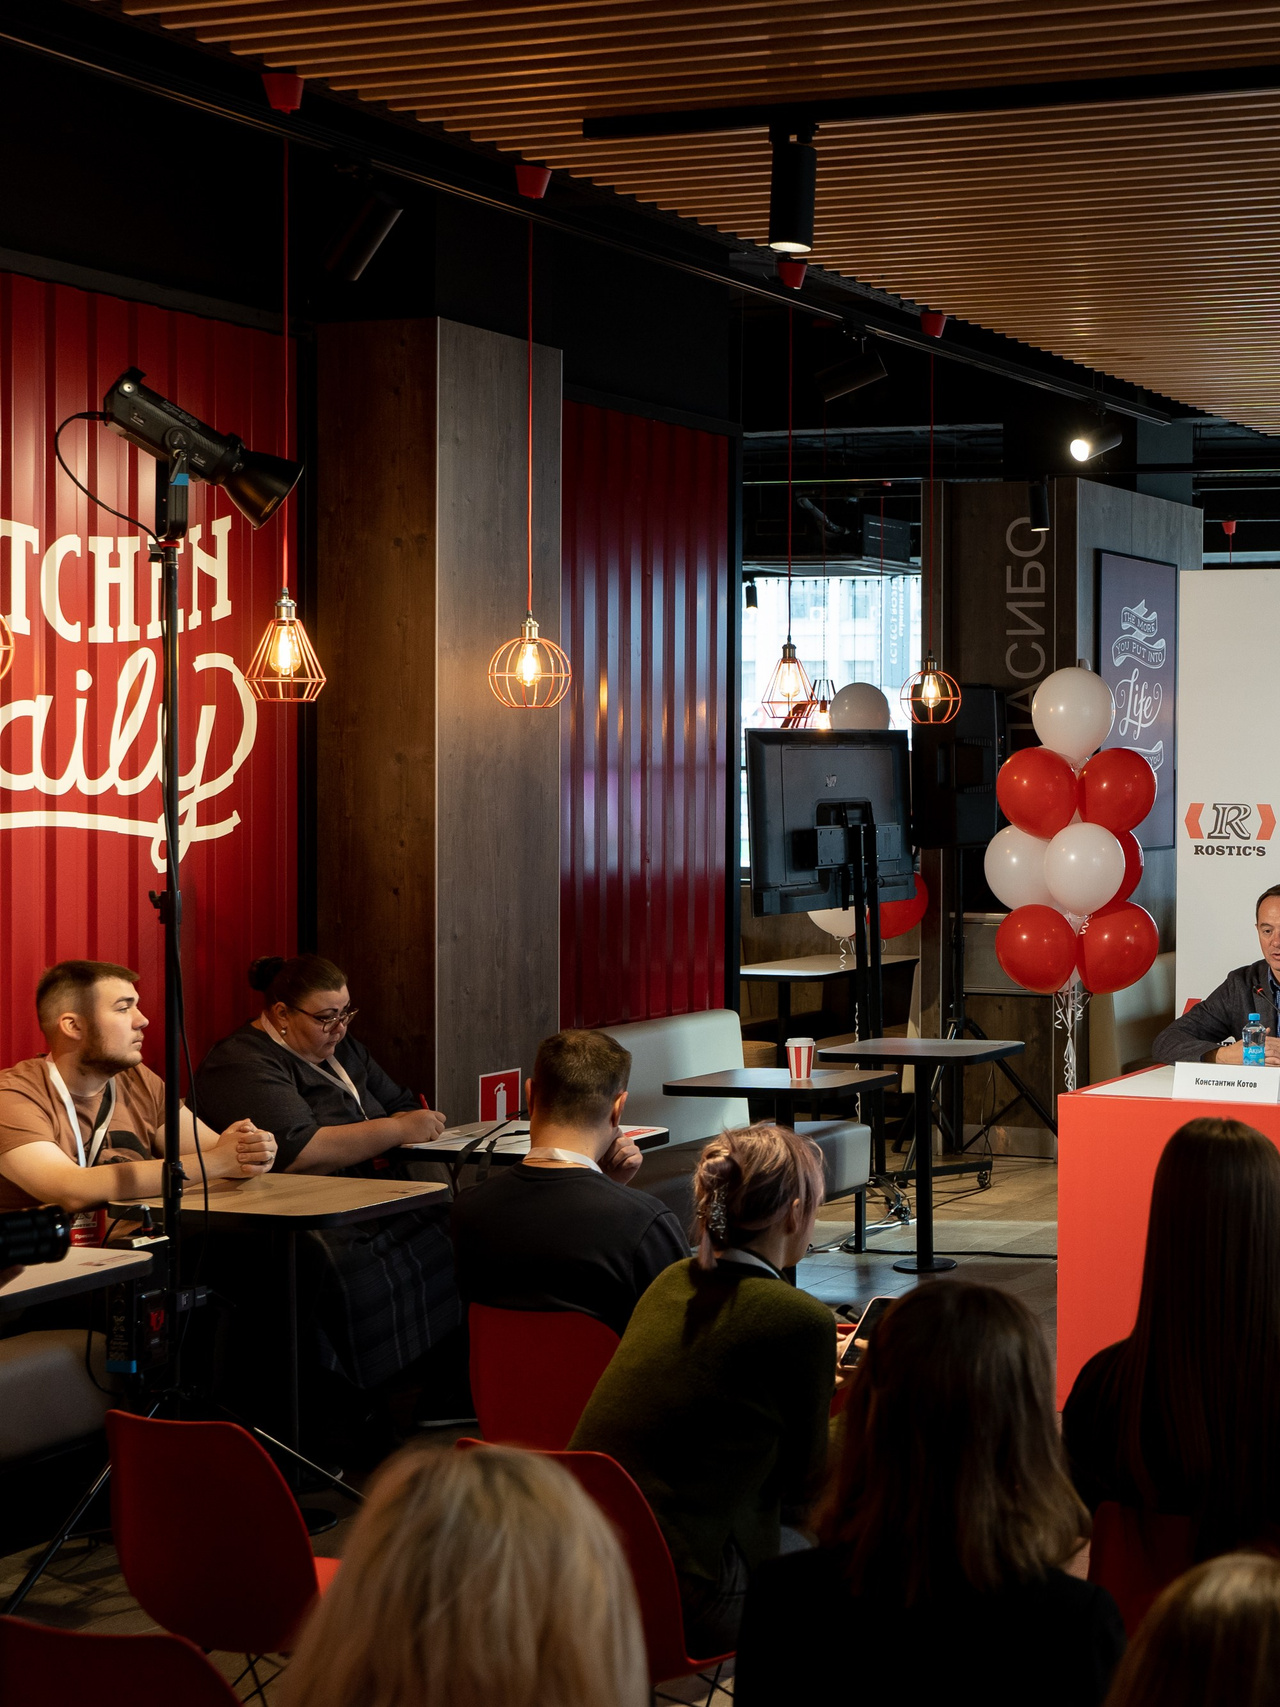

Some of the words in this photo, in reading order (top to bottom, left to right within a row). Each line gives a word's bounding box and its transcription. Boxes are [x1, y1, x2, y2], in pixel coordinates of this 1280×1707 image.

[1124, 612, 1136, 624] THE
[1137, 619, 1156, 632] MORE
[1116, 641, 1130, 654] YOU
[1132, 642, 1147, 658] PUT
[1148, 651, 1163, 663] INTO
[1115, 668, 1162, 740] Life
[1207, 803, 1252, 840] R
[1193, 845, 1266, 857] ROSTIC'S
[1195, 1077, 1236, 1087] Константин
[1237, 1079, 1257, 1088] Котов
